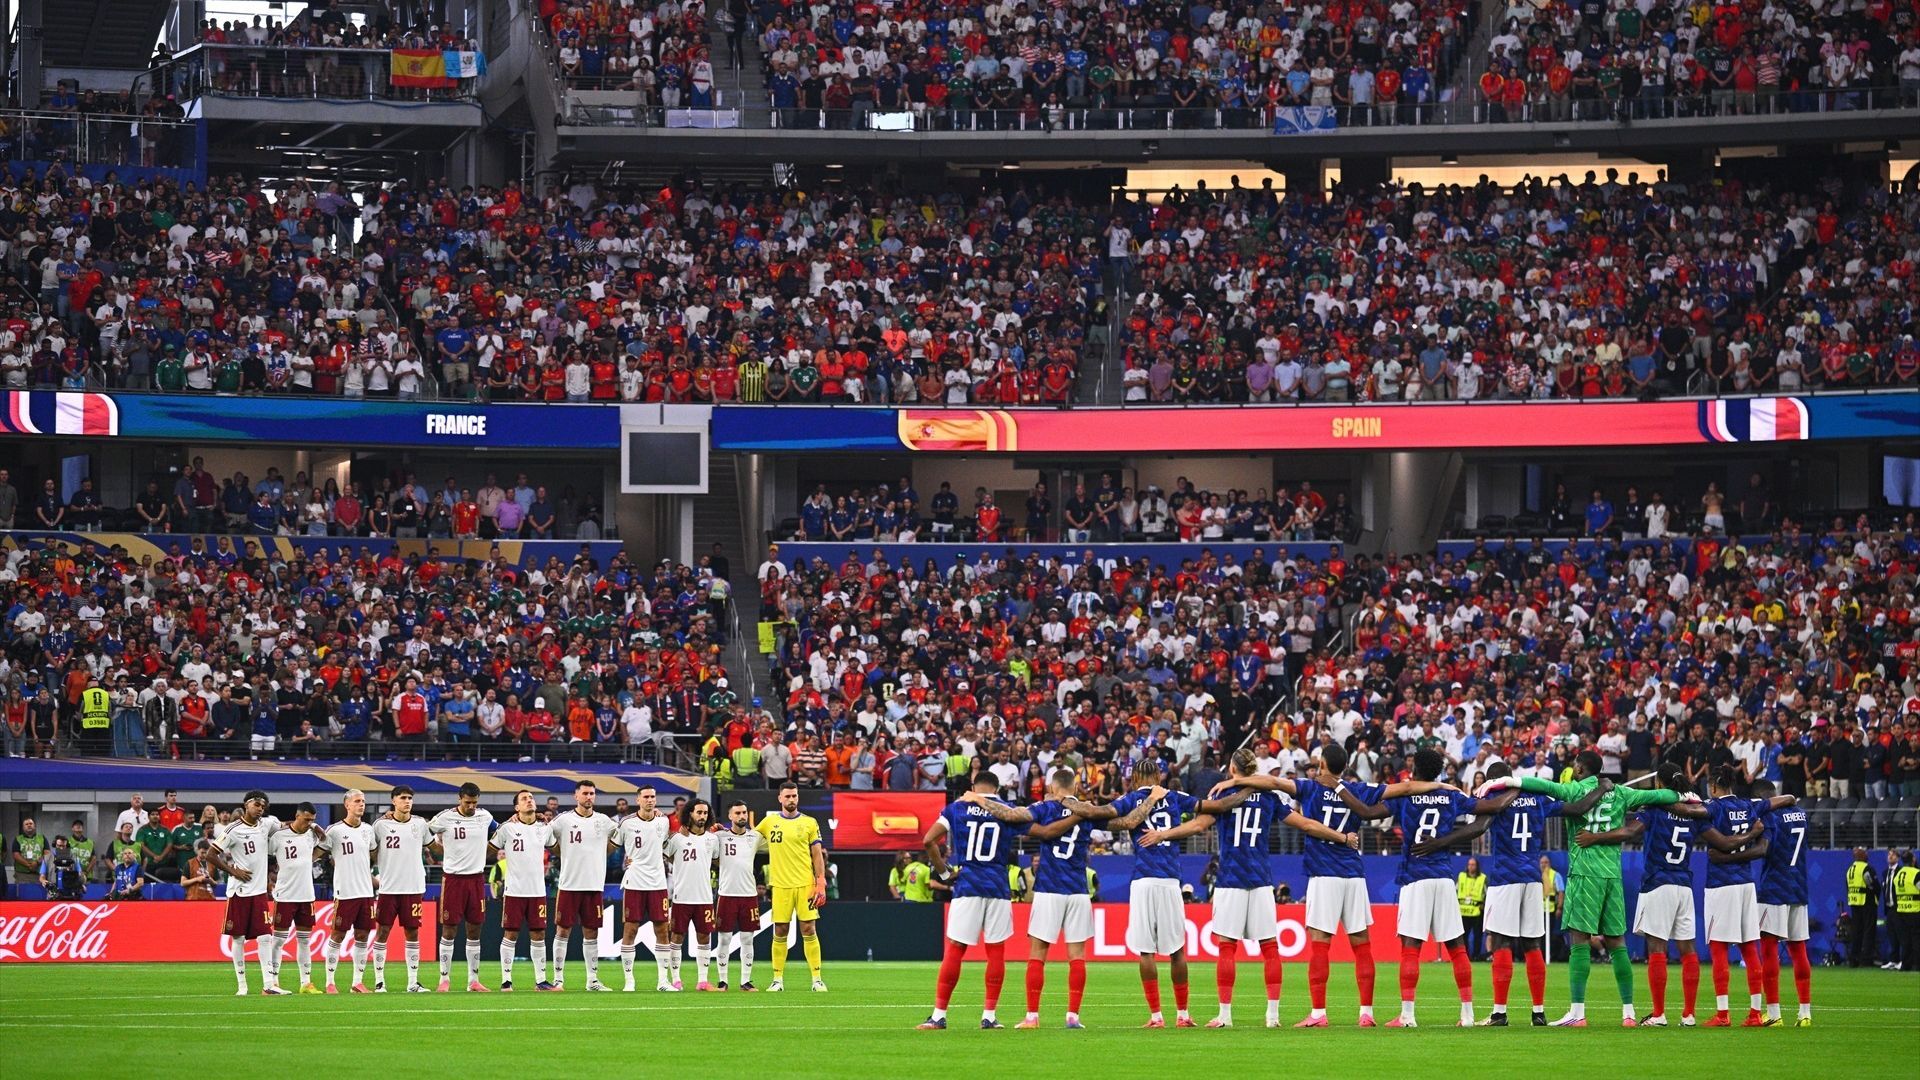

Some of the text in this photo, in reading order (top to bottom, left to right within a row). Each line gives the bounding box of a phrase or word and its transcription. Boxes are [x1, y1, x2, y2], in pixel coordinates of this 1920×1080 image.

[426, 413, 487, 436] FRANCE
[1332, 416, 1382, 438] SPAIN
[1323, 790, 1344, 802] SALI
[454, 827, 467, 840] 16
[1231, 807, 1262, 848] 14
[1414, 808, 1441, 844] 8
[1511, 812, 1533, 852] 4
[385, 836, 401, 849] 22
[569, 830, 583, 844] 14
[634, 836, 643, 849] 8
[770, 831, 783, 844] 23
[965, 820, 1001, 862] 10
[243, 840, 257, 856] 19
[284, 845, 298, 860] 12
[341, 841, 355, 856] 10
[512, 839, 525, 852] 21
[724, 843, 737, 856] 15
[1665, 826, 1690, 865] 5
[1789, 827, 1806, 867] 7
[683, 848, 697, 862] 24
[412, 903, 423, 917] 22
